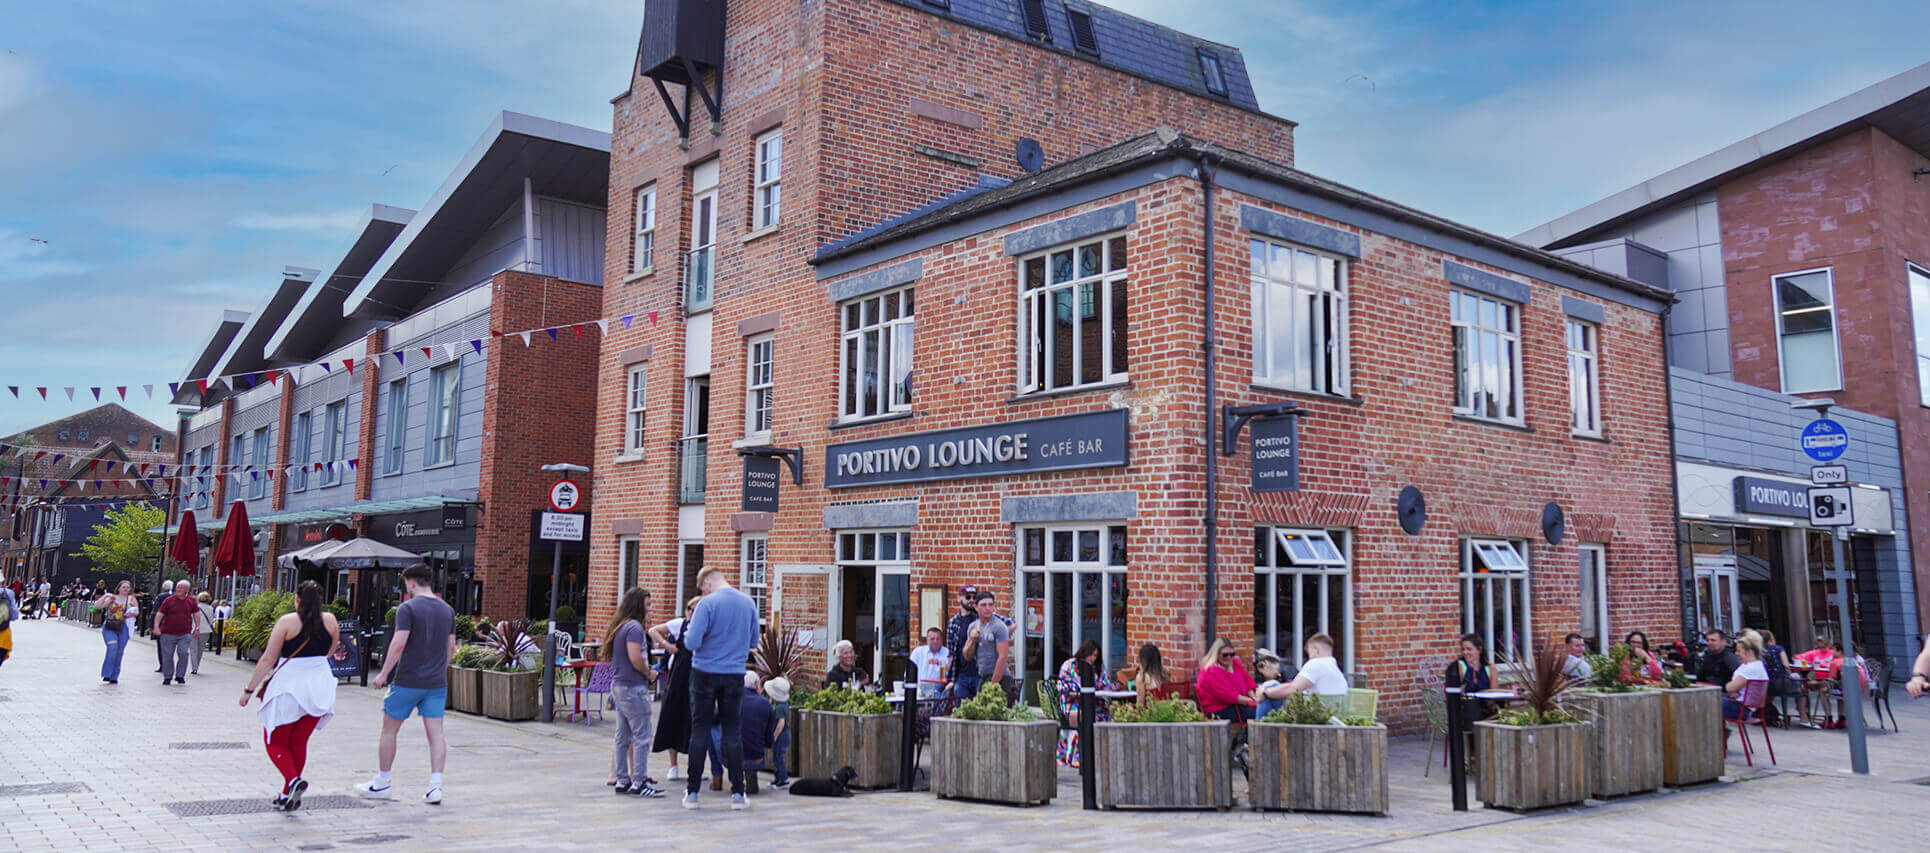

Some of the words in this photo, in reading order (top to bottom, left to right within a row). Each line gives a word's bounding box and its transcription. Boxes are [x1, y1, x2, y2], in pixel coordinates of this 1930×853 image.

[1255, 436, 1290, 447] PORTIVO
[837, 446, 921, 476] PORTIVO
[928, 433, 1029, 468] LOUNGE
[1040, 438, 1072, 458] CAFÉ
[1077, 438, 1103, 454] BAR
[1255, 448, 1290, 459] LOUNGE
[748, 471, 776, 480] PORTIVO
[1816, 470, 1841, 480] Only
[748, 480, 776, 488] LOUNGE
[1750, 486, 1790, 507] PORTIVO
